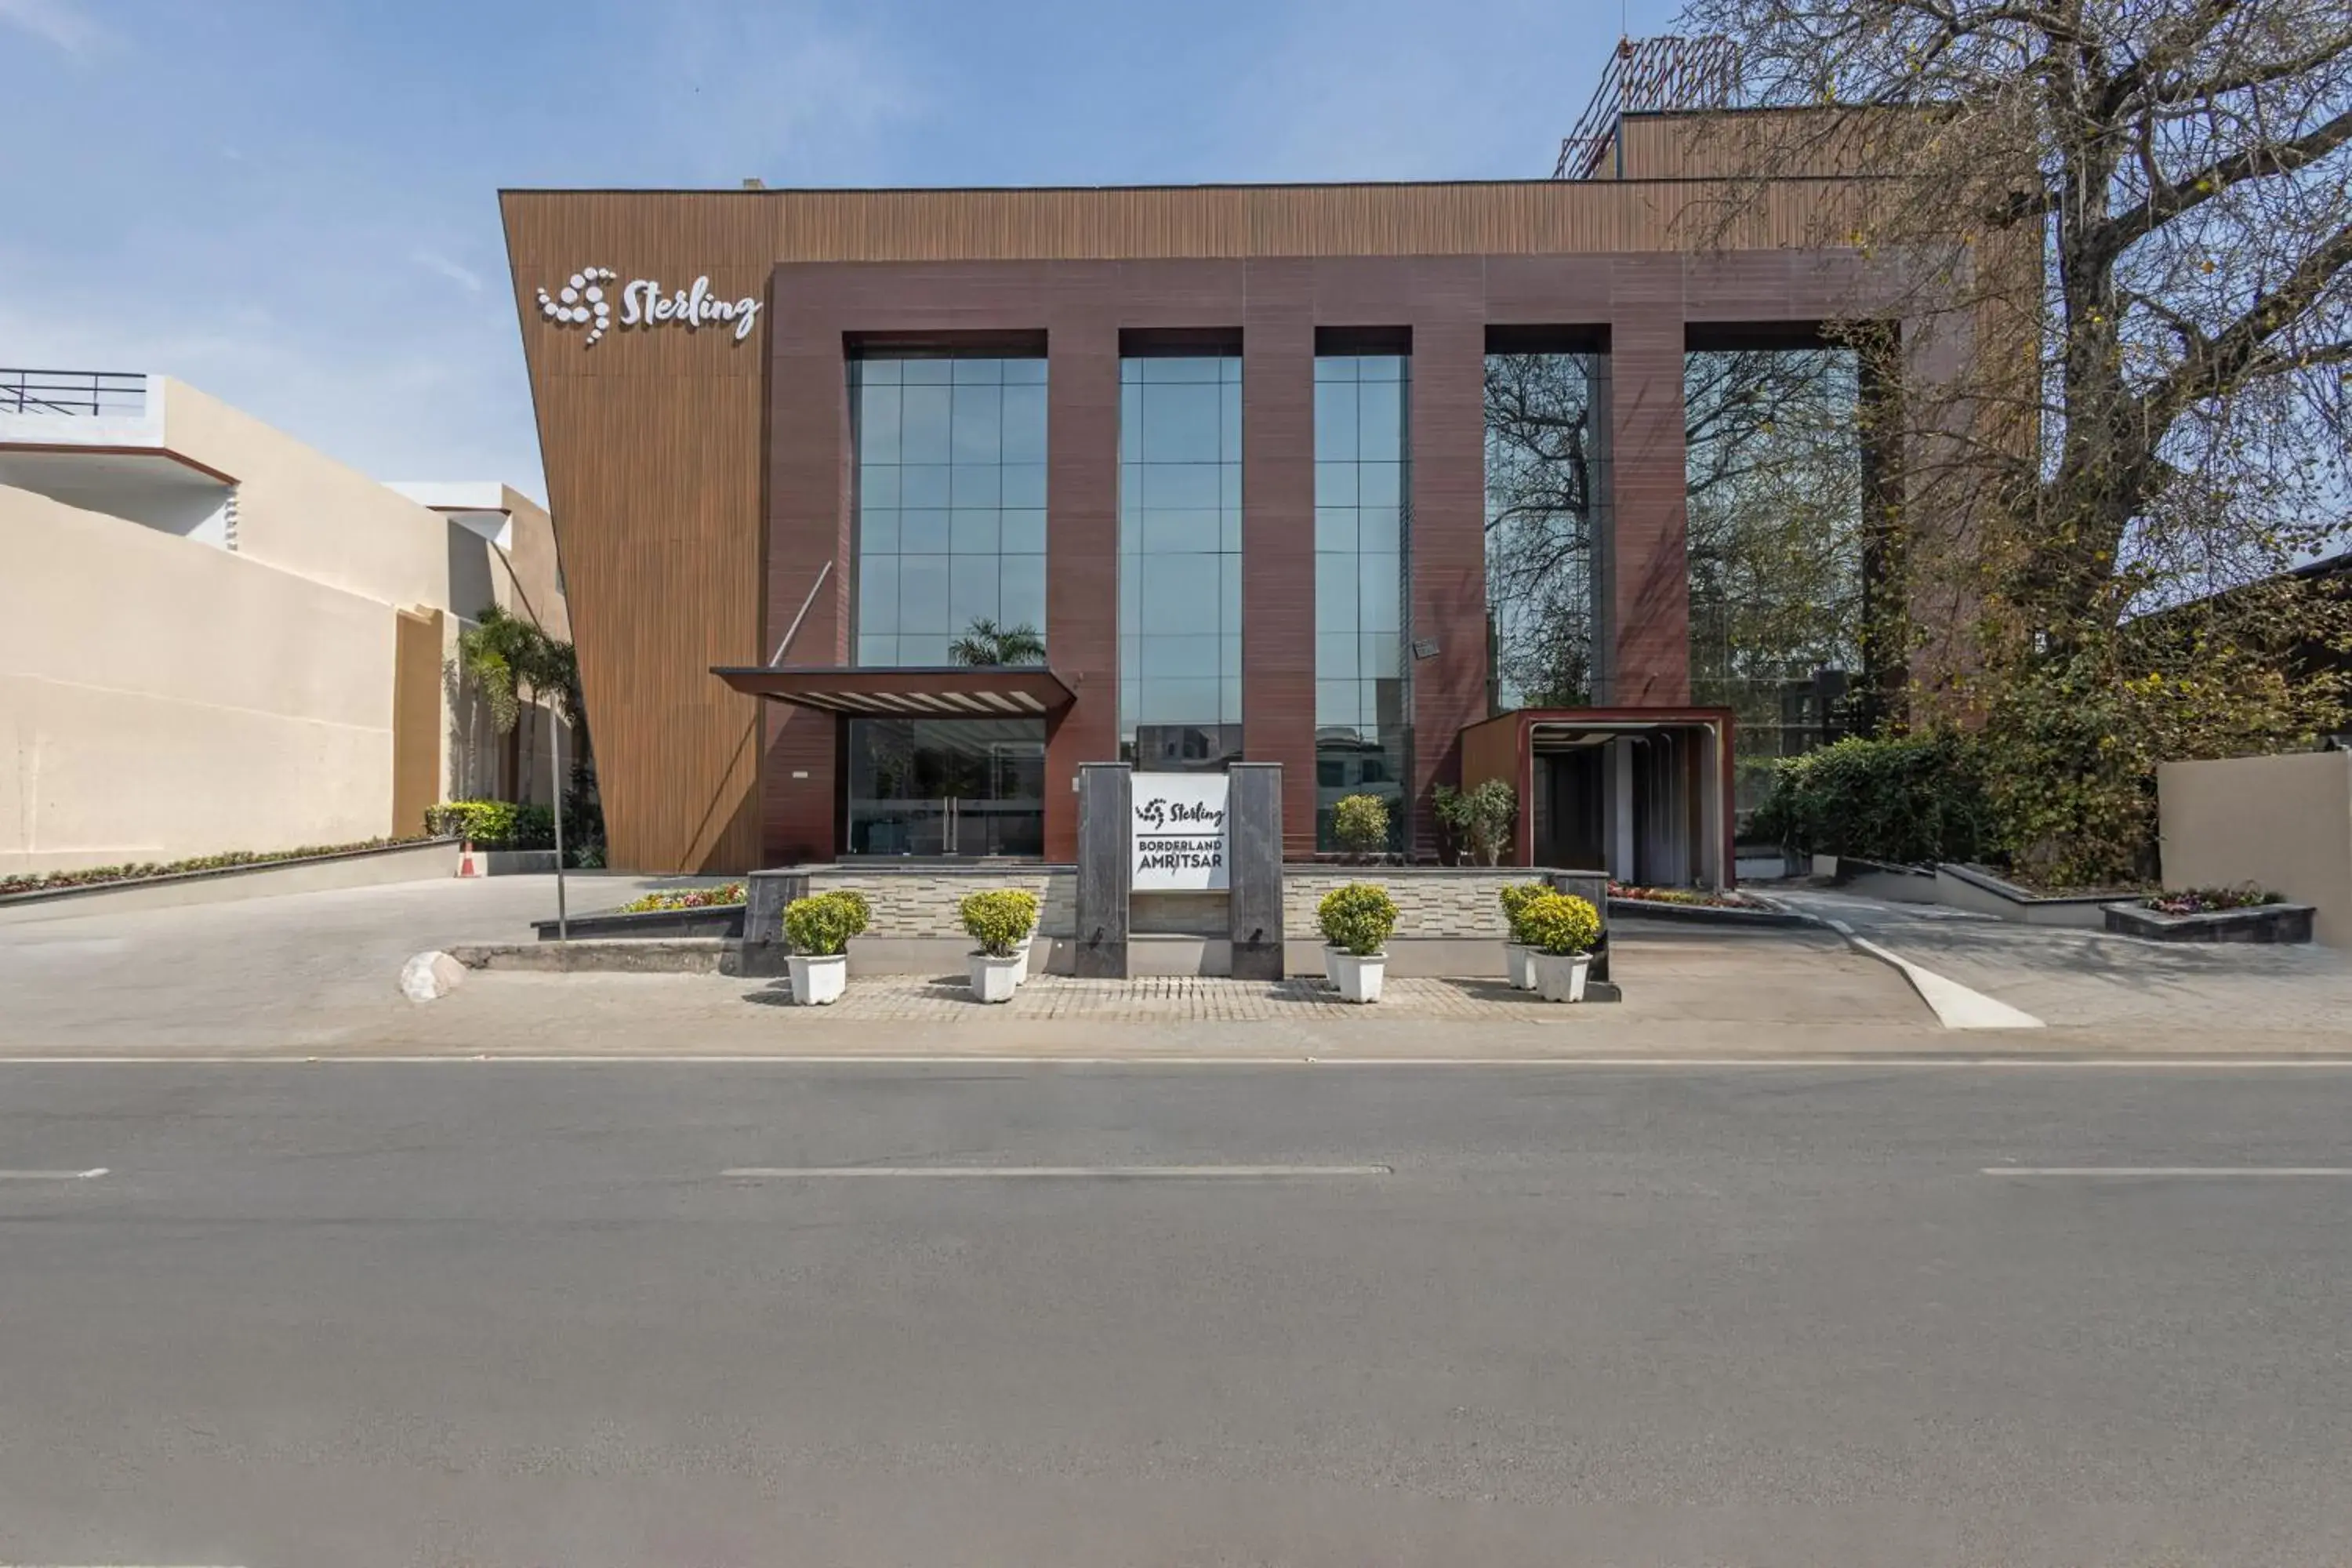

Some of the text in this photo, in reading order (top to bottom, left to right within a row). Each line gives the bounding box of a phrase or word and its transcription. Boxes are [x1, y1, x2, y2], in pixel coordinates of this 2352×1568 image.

[619, 276, 763, 339] Sterling
[1171, 801, 1225, 827] Sterling
[1139, 840, 1222, 851] BORDERLAND
[1140, 854, 1222, 868] AMRITSAR
